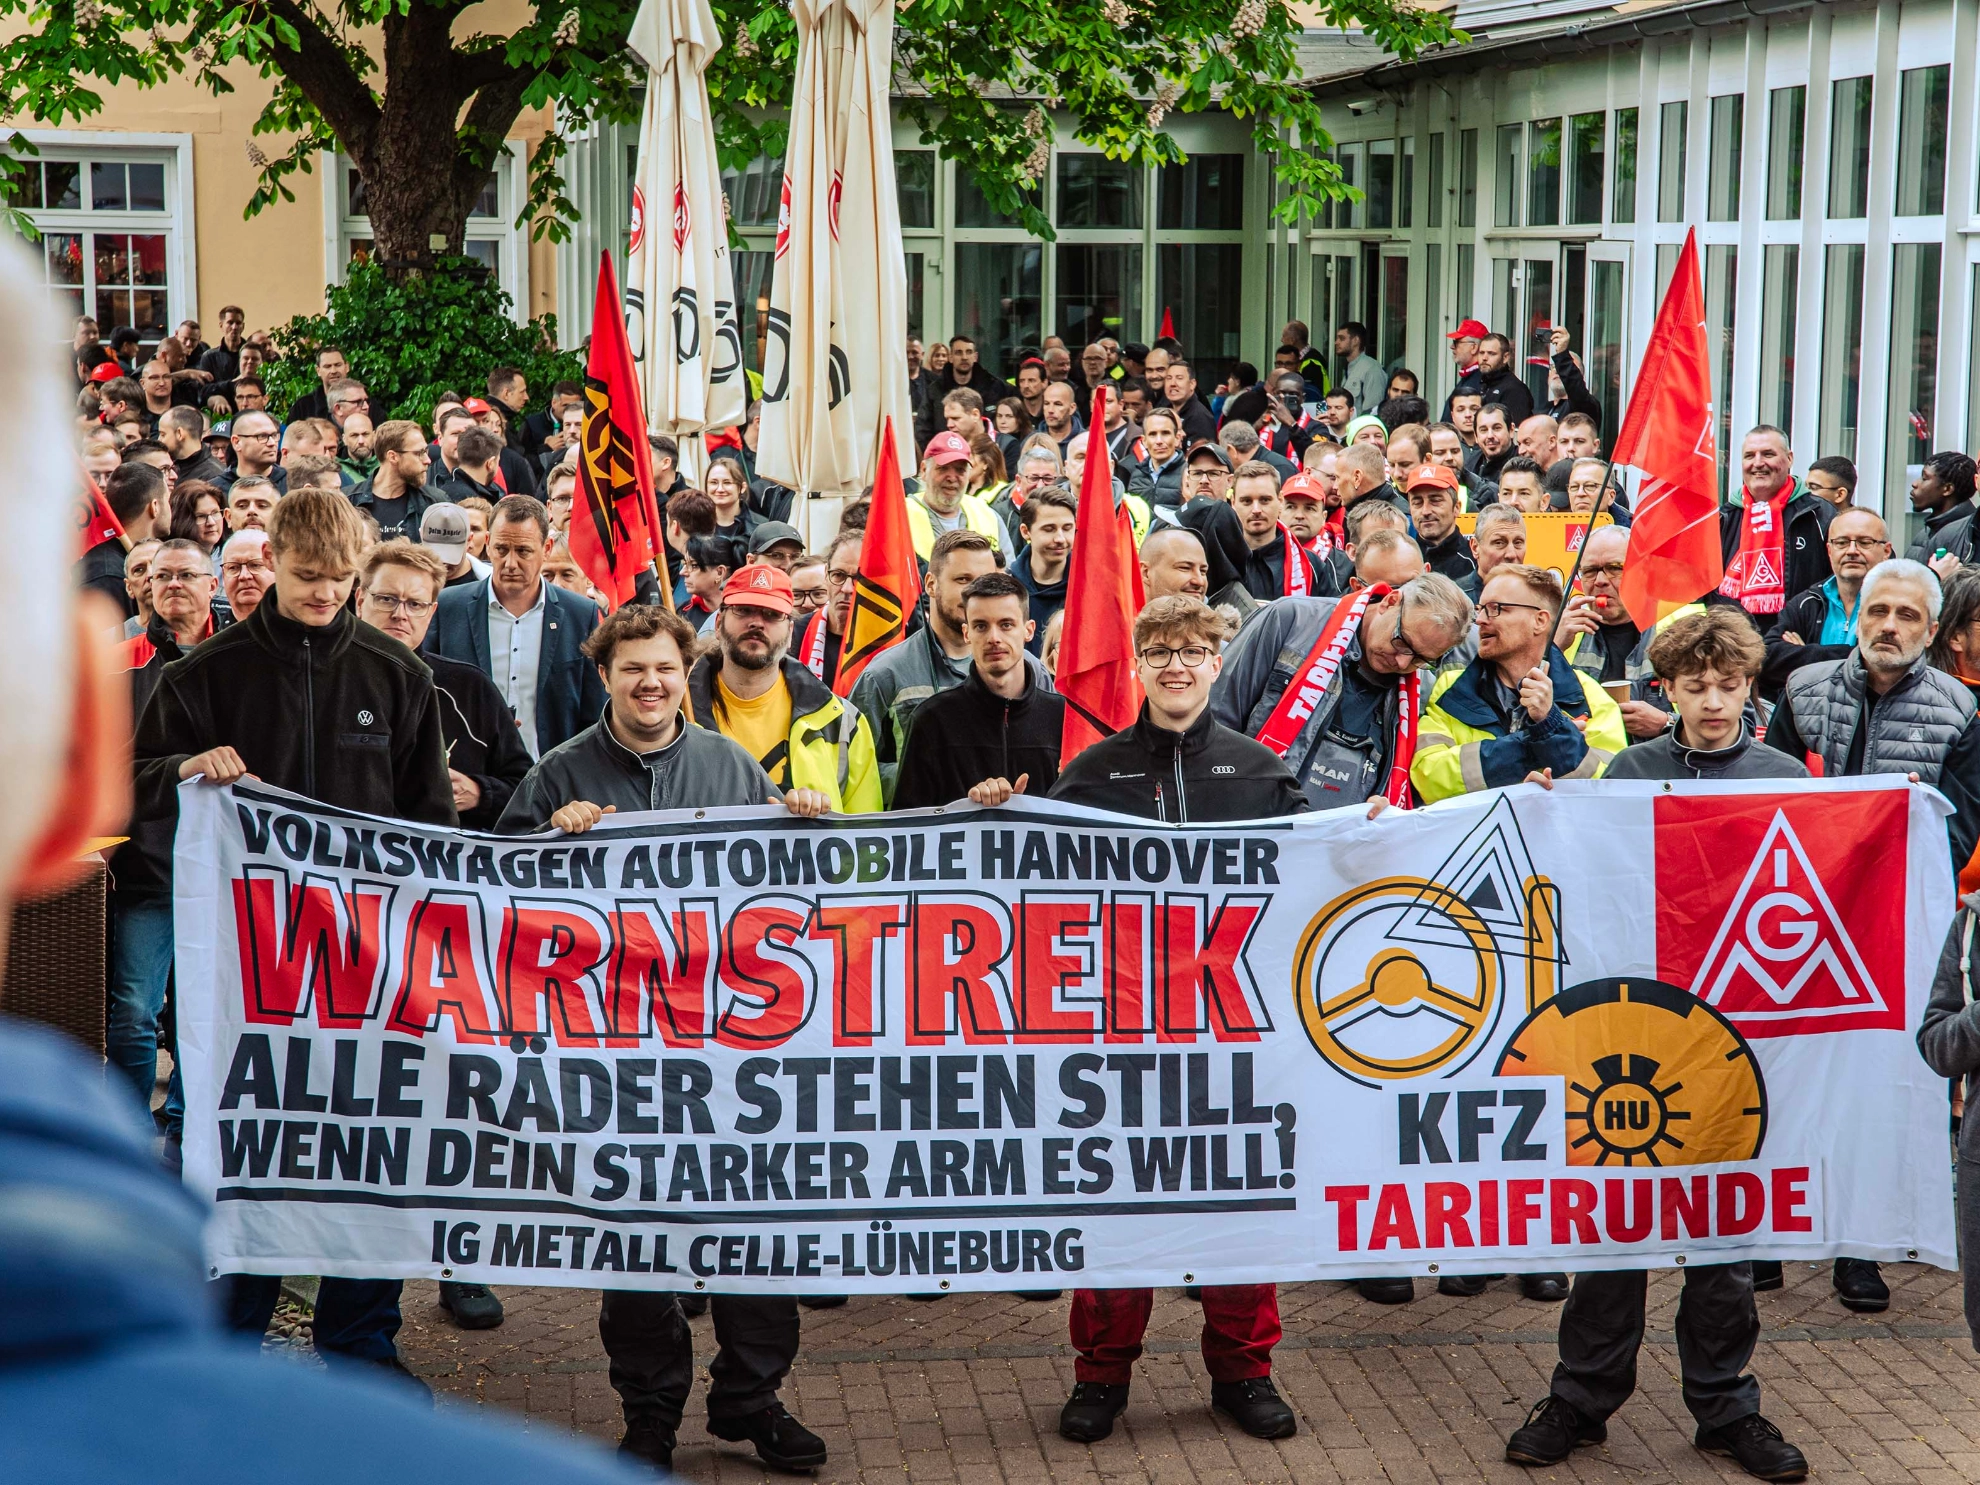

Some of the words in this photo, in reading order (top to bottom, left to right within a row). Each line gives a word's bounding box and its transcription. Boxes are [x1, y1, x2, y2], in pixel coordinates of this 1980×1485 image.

[1310, 761, 1351, 782] MAN
[235, 802, 611, 889] VOLKSWAGEN
[620, 830, 967, 889] AUTOMOBILE
[980, 829, 1281, 885] HANNOVER
[231, 863, 1276, 1051] WARNSTREIK
[218, 1033, 425, 1118] ALLE
[445, 1034, 716, 1135] RÄDER
[734, 1053, 1036, 1134] STEHEN
[1058, 1051, 1297, 1138] STILL,
[1398, 1088, 1548, 1166] KFZ
[1603, 1098, 1651, 1132] HU
[217, 1119, 412, 1186] WENN
[425, 1129, 576, 1197] DEIN
[590, 1140, 870, 1202] STARKER
[884, 1138, 1027, 1199] ARM
[1042, 1137, 1115, 1195] ES
[1128, 1130, 1297, 1192] WILL!
[431, 1220, 482, 1266] IG
[491, 1223, 678, 1274] METALL
[687, 1220, 1085, 1277] CELLE-LÜNEBURG
[1324, 1166, 1813, 1252] TARIFRUNDE
